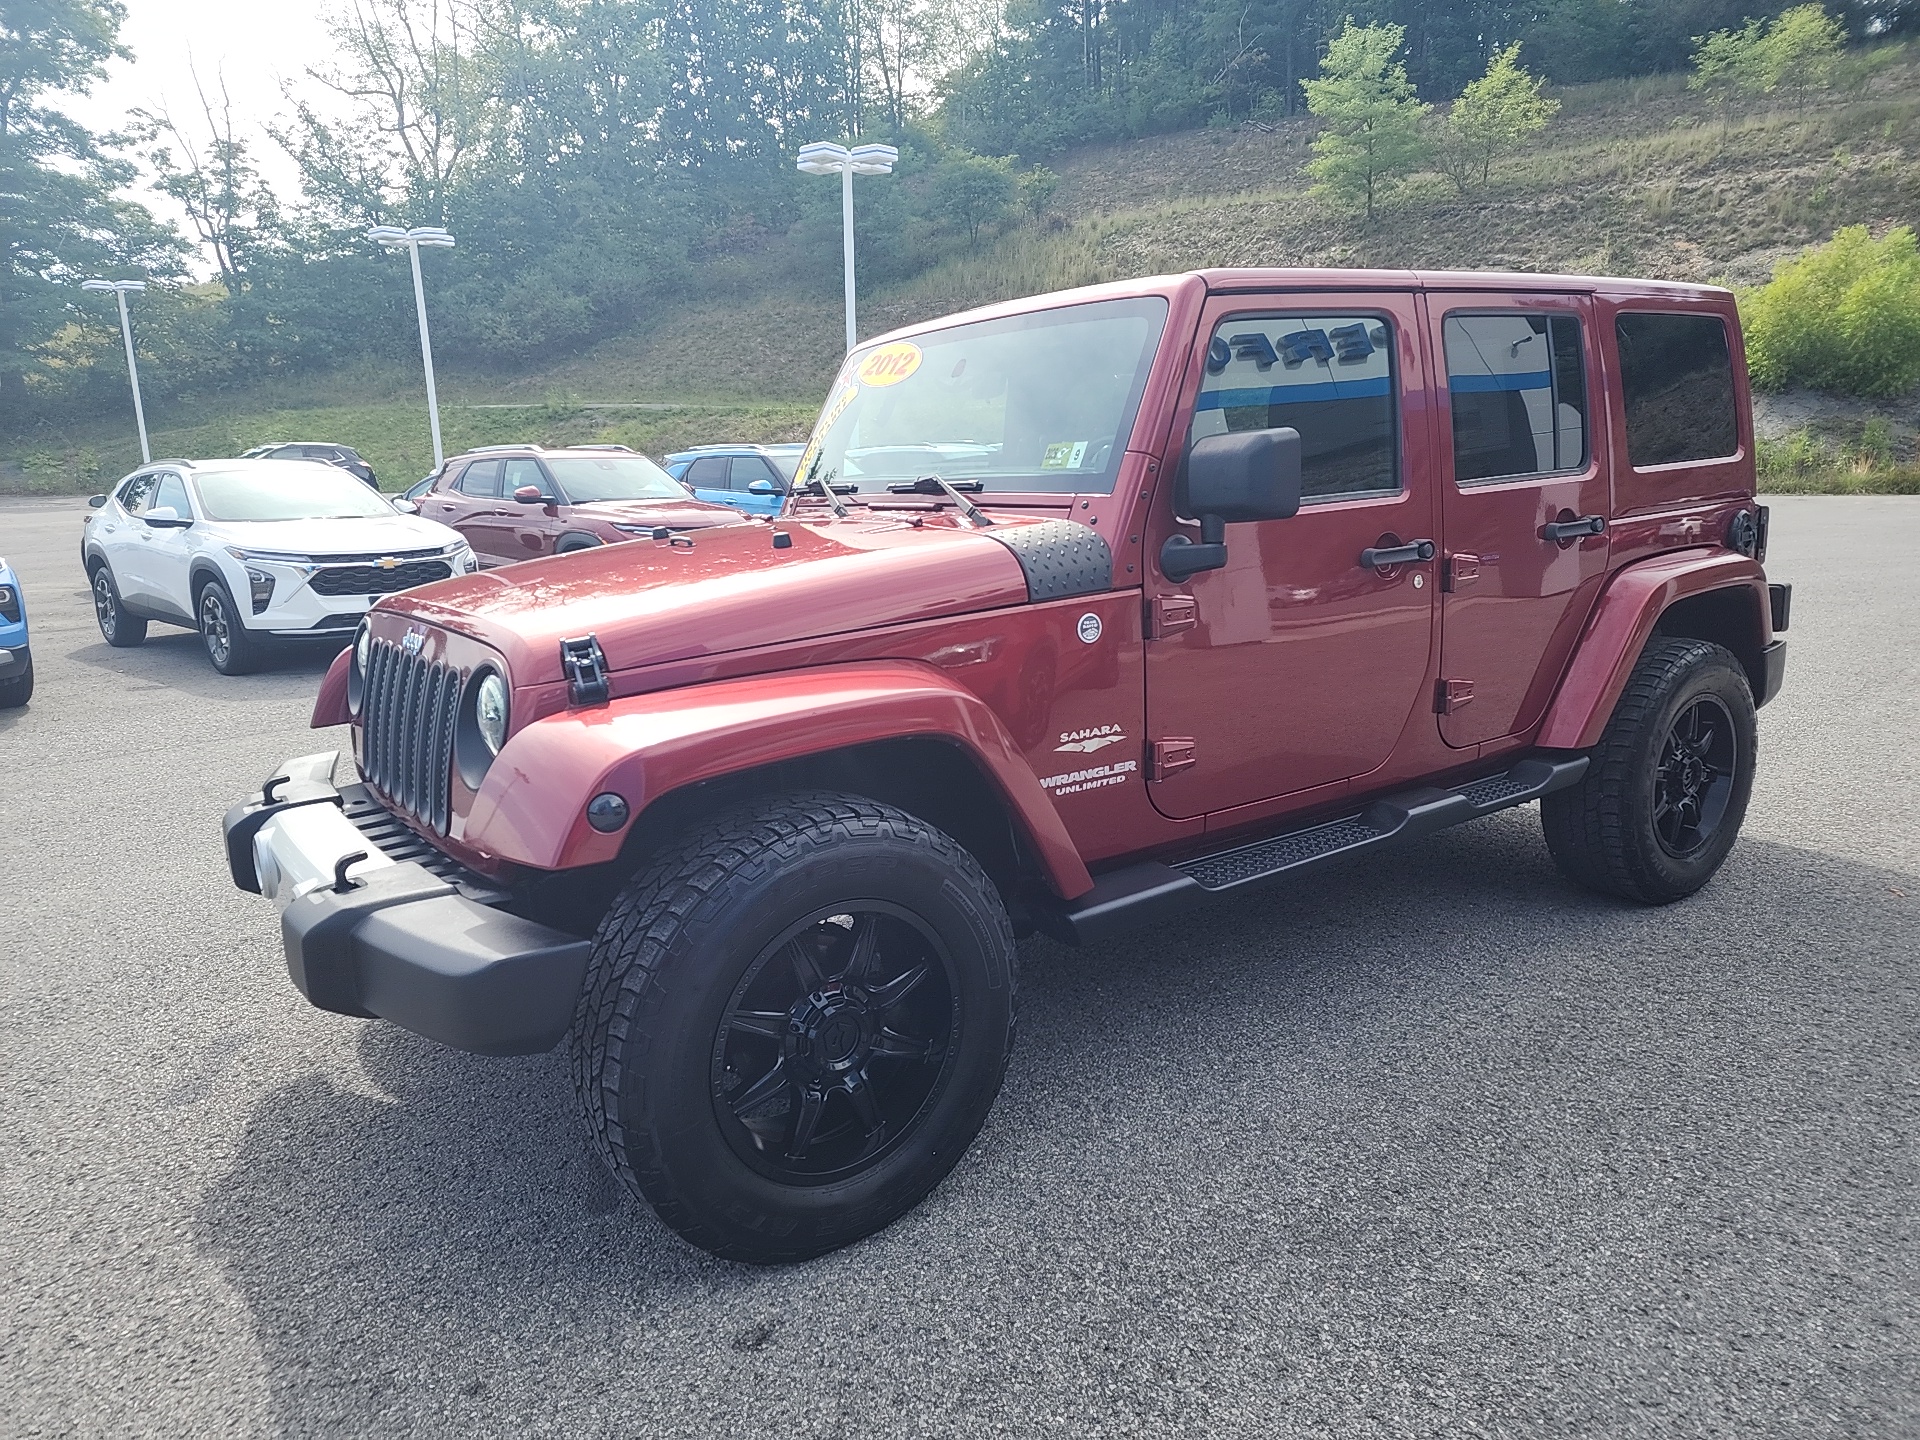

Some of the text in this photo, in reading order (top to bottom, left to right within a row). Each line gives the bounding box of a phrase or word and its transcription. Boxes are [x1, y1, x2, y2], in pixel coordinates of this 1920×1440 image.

[862, 352, 915, 377] 2012
[1059, 723, 1122, 743] SAHARA
[1039, 760, 1137, 789] WRANGLER
[1055, 775, 1126, 796] UNLIMITED
